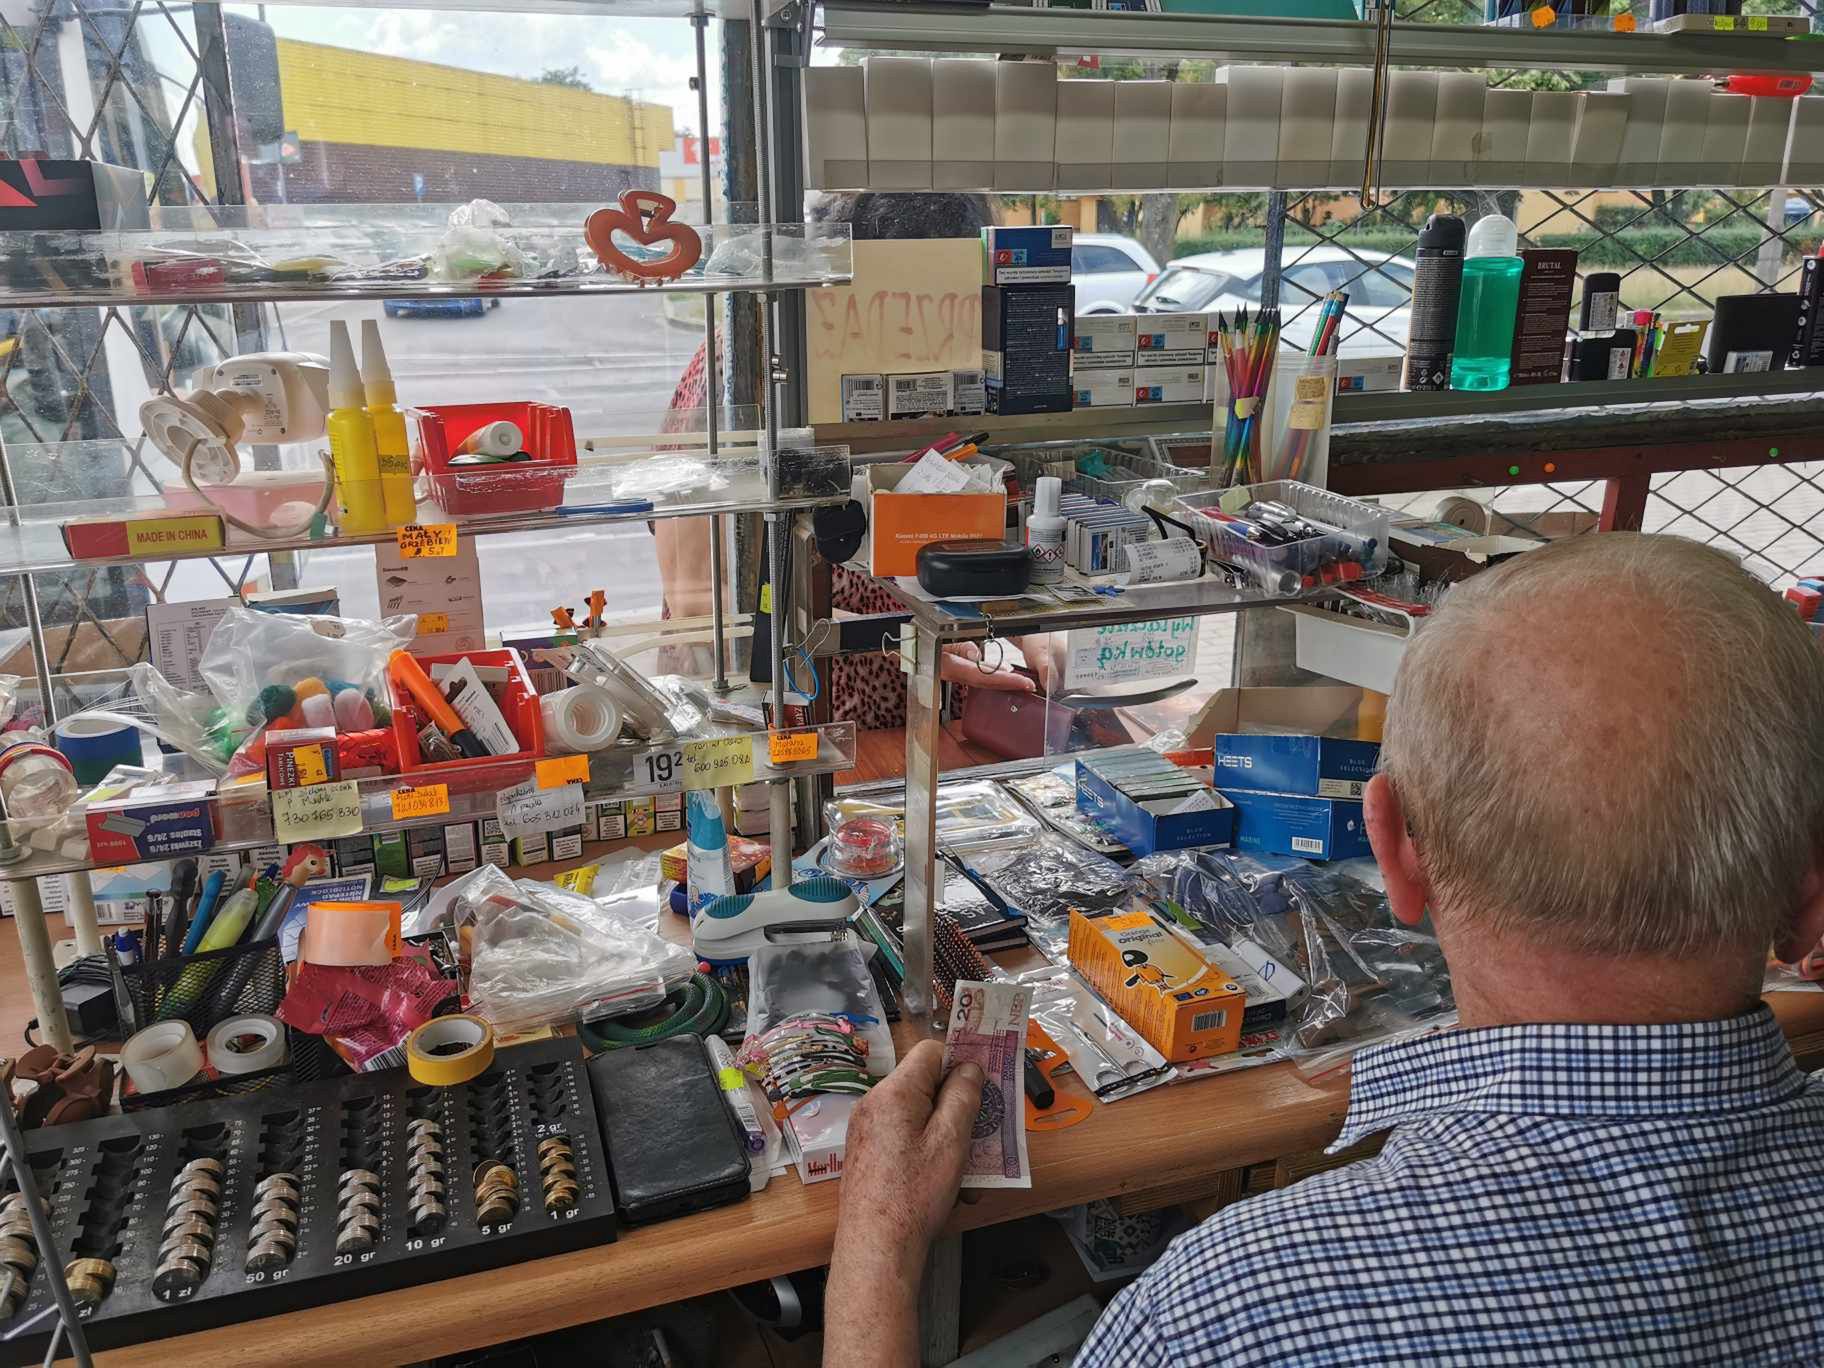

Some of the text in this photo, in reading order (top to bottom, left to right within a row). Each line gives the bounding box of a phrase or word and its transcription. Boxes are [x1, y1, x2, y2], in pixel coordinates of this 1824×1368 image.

[136, 529, 208, 544] MADE IN CHINA
[1218, 756, 1252, 768] HEETS
[957, 992, 972, 1022] 20
[1009, 992, 1026, 1026] NBP
[537, 1122, 562, 1132] 2 gr
[550, 1208, 580, 1220] 1 gr
[482, 1222, 512, 1236] 5 gr
[405, 1236, 446, 1251] 10 gr
[334, 1250, 376, 1266] 20 gr
[245, 1268, 289, 1284] 50 gr
[163, 1289, 170, 1300] 1
